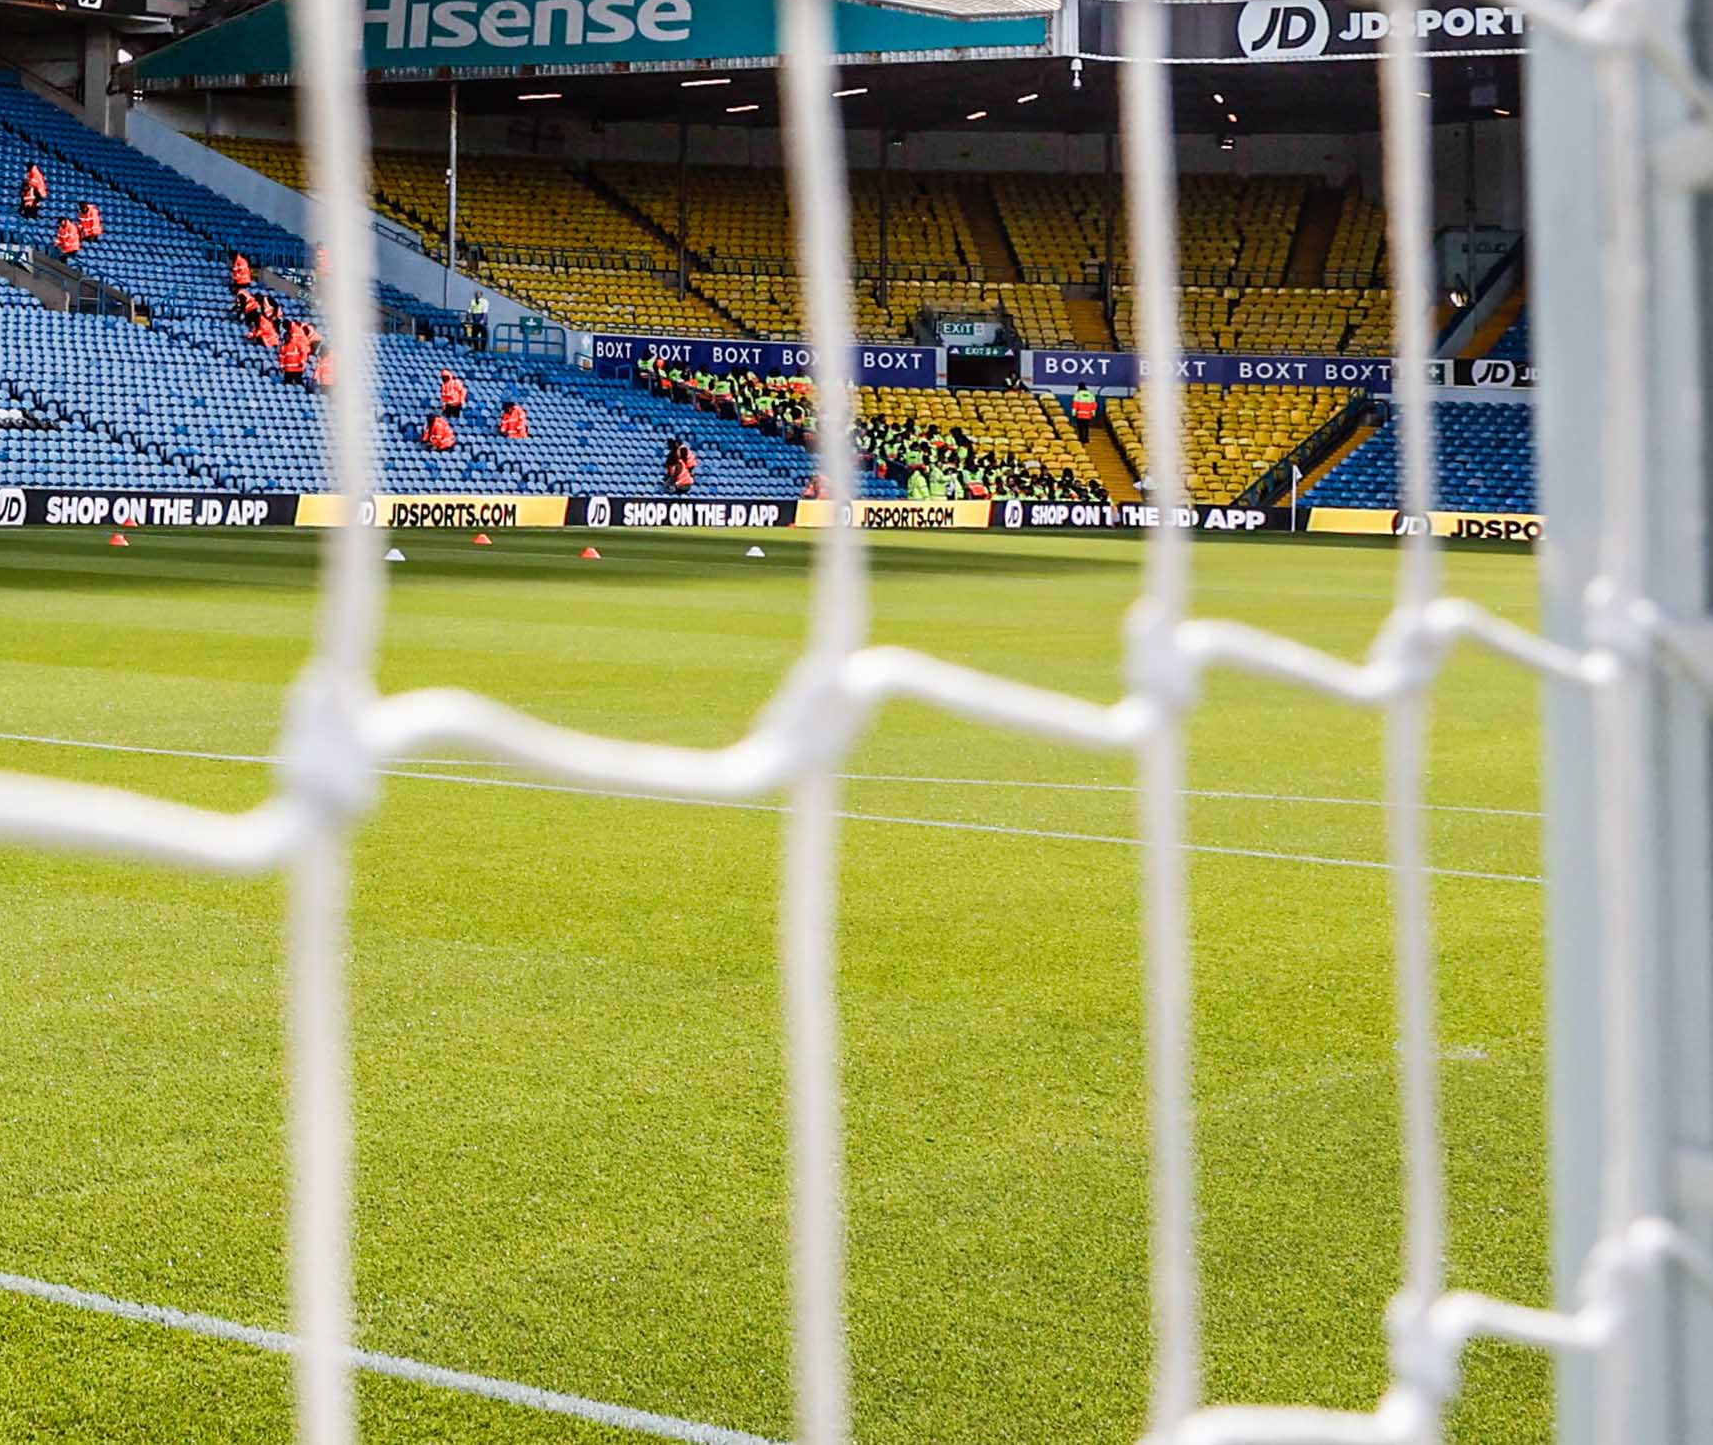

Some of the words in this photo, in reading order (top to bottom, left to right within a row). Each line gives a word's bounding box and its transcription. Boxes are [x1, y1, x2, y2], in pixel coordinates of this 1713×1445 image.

[1250, 6, 1316, 51] JD
[1339, 7, 1523, 41] JDPORT
[943, 323, 972, 333] EXIT
[596, 341, 632, 360] BOXT
[648, 344, 692, 362] BOXT
[712, 347, 762, 365] BOXT
[782, 350, 821, 367] BOX
[863, 352, 923, 371] BOXT
[1044, 357, 1111, 376] BOXT
[1139, 360, 1206, 377] BXT
[1238, 362, 1308, 381] BOXT
[1325, 364, 1391, 382] BOXT
[1477, 363, 1510, 383] JD
[46, 495, 108, 525] SHOP
[113, 498, 146, 524] ON
[150, 499, 192, 525] THE
[196, 499, 223, 525] JD
[226, 499, 268, 526] APP
[389, 503, 516, 527] JDSPORTS.COM
[591, 500, 607, 524] JD
[623, 505, 667, 526] SHOP
[670, 506, 694, 526] ON
[695, 505, 724, 527] THE
[727, 505, 746, 527] JD
[748, 505, 779, 527] APP
[861, 507, 954, 528] JDSPORTS.COM
[1031, 506, 1069, 526] SHOP
[1072, 507, 1100, 526] ON
[1204, 509, 1267, 530] APP
